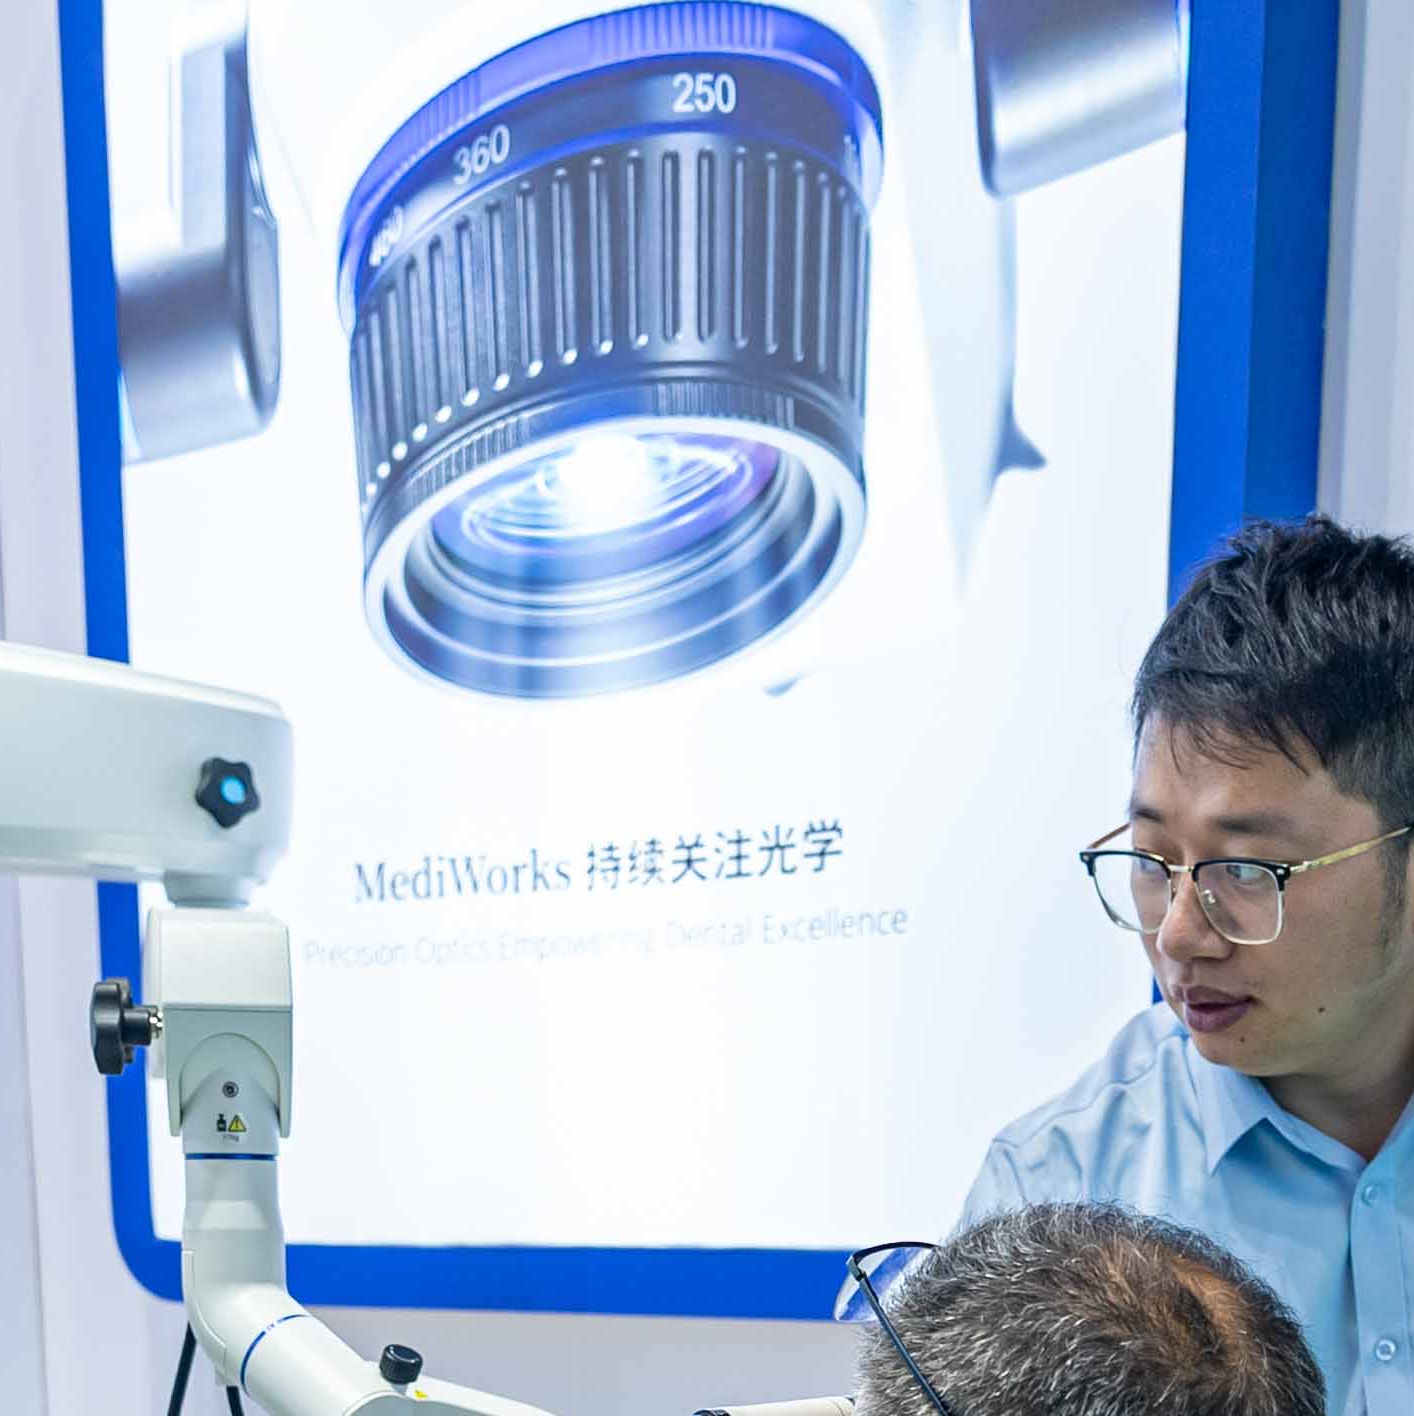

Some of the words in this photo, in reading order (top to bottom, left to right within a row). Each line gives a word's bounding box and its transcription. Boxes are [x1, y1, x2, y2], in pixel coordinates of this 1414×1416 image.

[672, 72, 737, 114] 250
[453, 124, 510, 184] 360
[354, 848, 572, 903] MediWorks
[585, 818, 844, 891] 持续关注光学
[762, 906, 908, 944] Excellence
